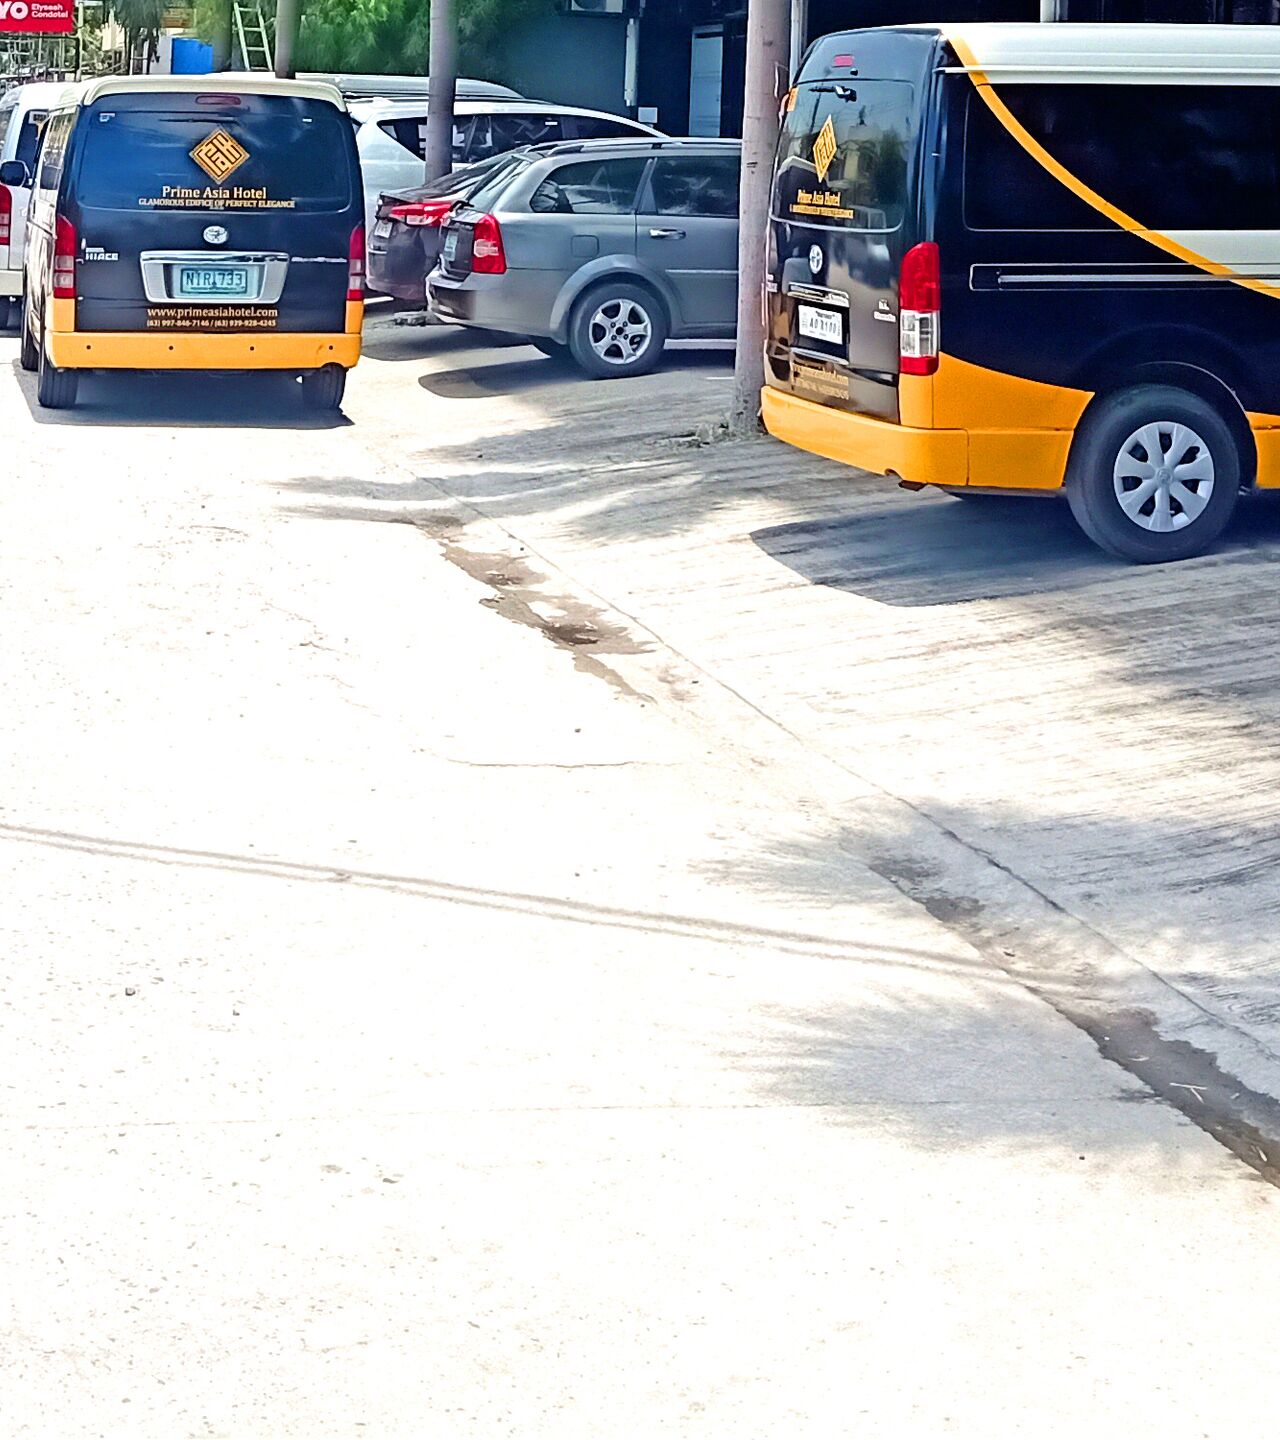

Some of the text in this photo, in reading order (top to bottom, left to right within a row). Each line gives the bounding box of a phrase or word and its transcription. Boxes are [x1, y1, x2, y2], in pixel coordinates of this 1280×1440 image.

[31, 10, 68, 18] Condotel
[162, 185, 267, 199] Prime Asia Hotel
[138, 198, 185, 207] GLAMOROUS
[214, 199, 225, 208] OF
[225, 199, 258, 208] PERFECT
[258, 200, 296, 209] ELEGANCE
[85, 252, 119, 261] HIACE
[186, 272, 243, 287] NIR 733
[147, 306, 278, 319] www.primeasiahotel.com
